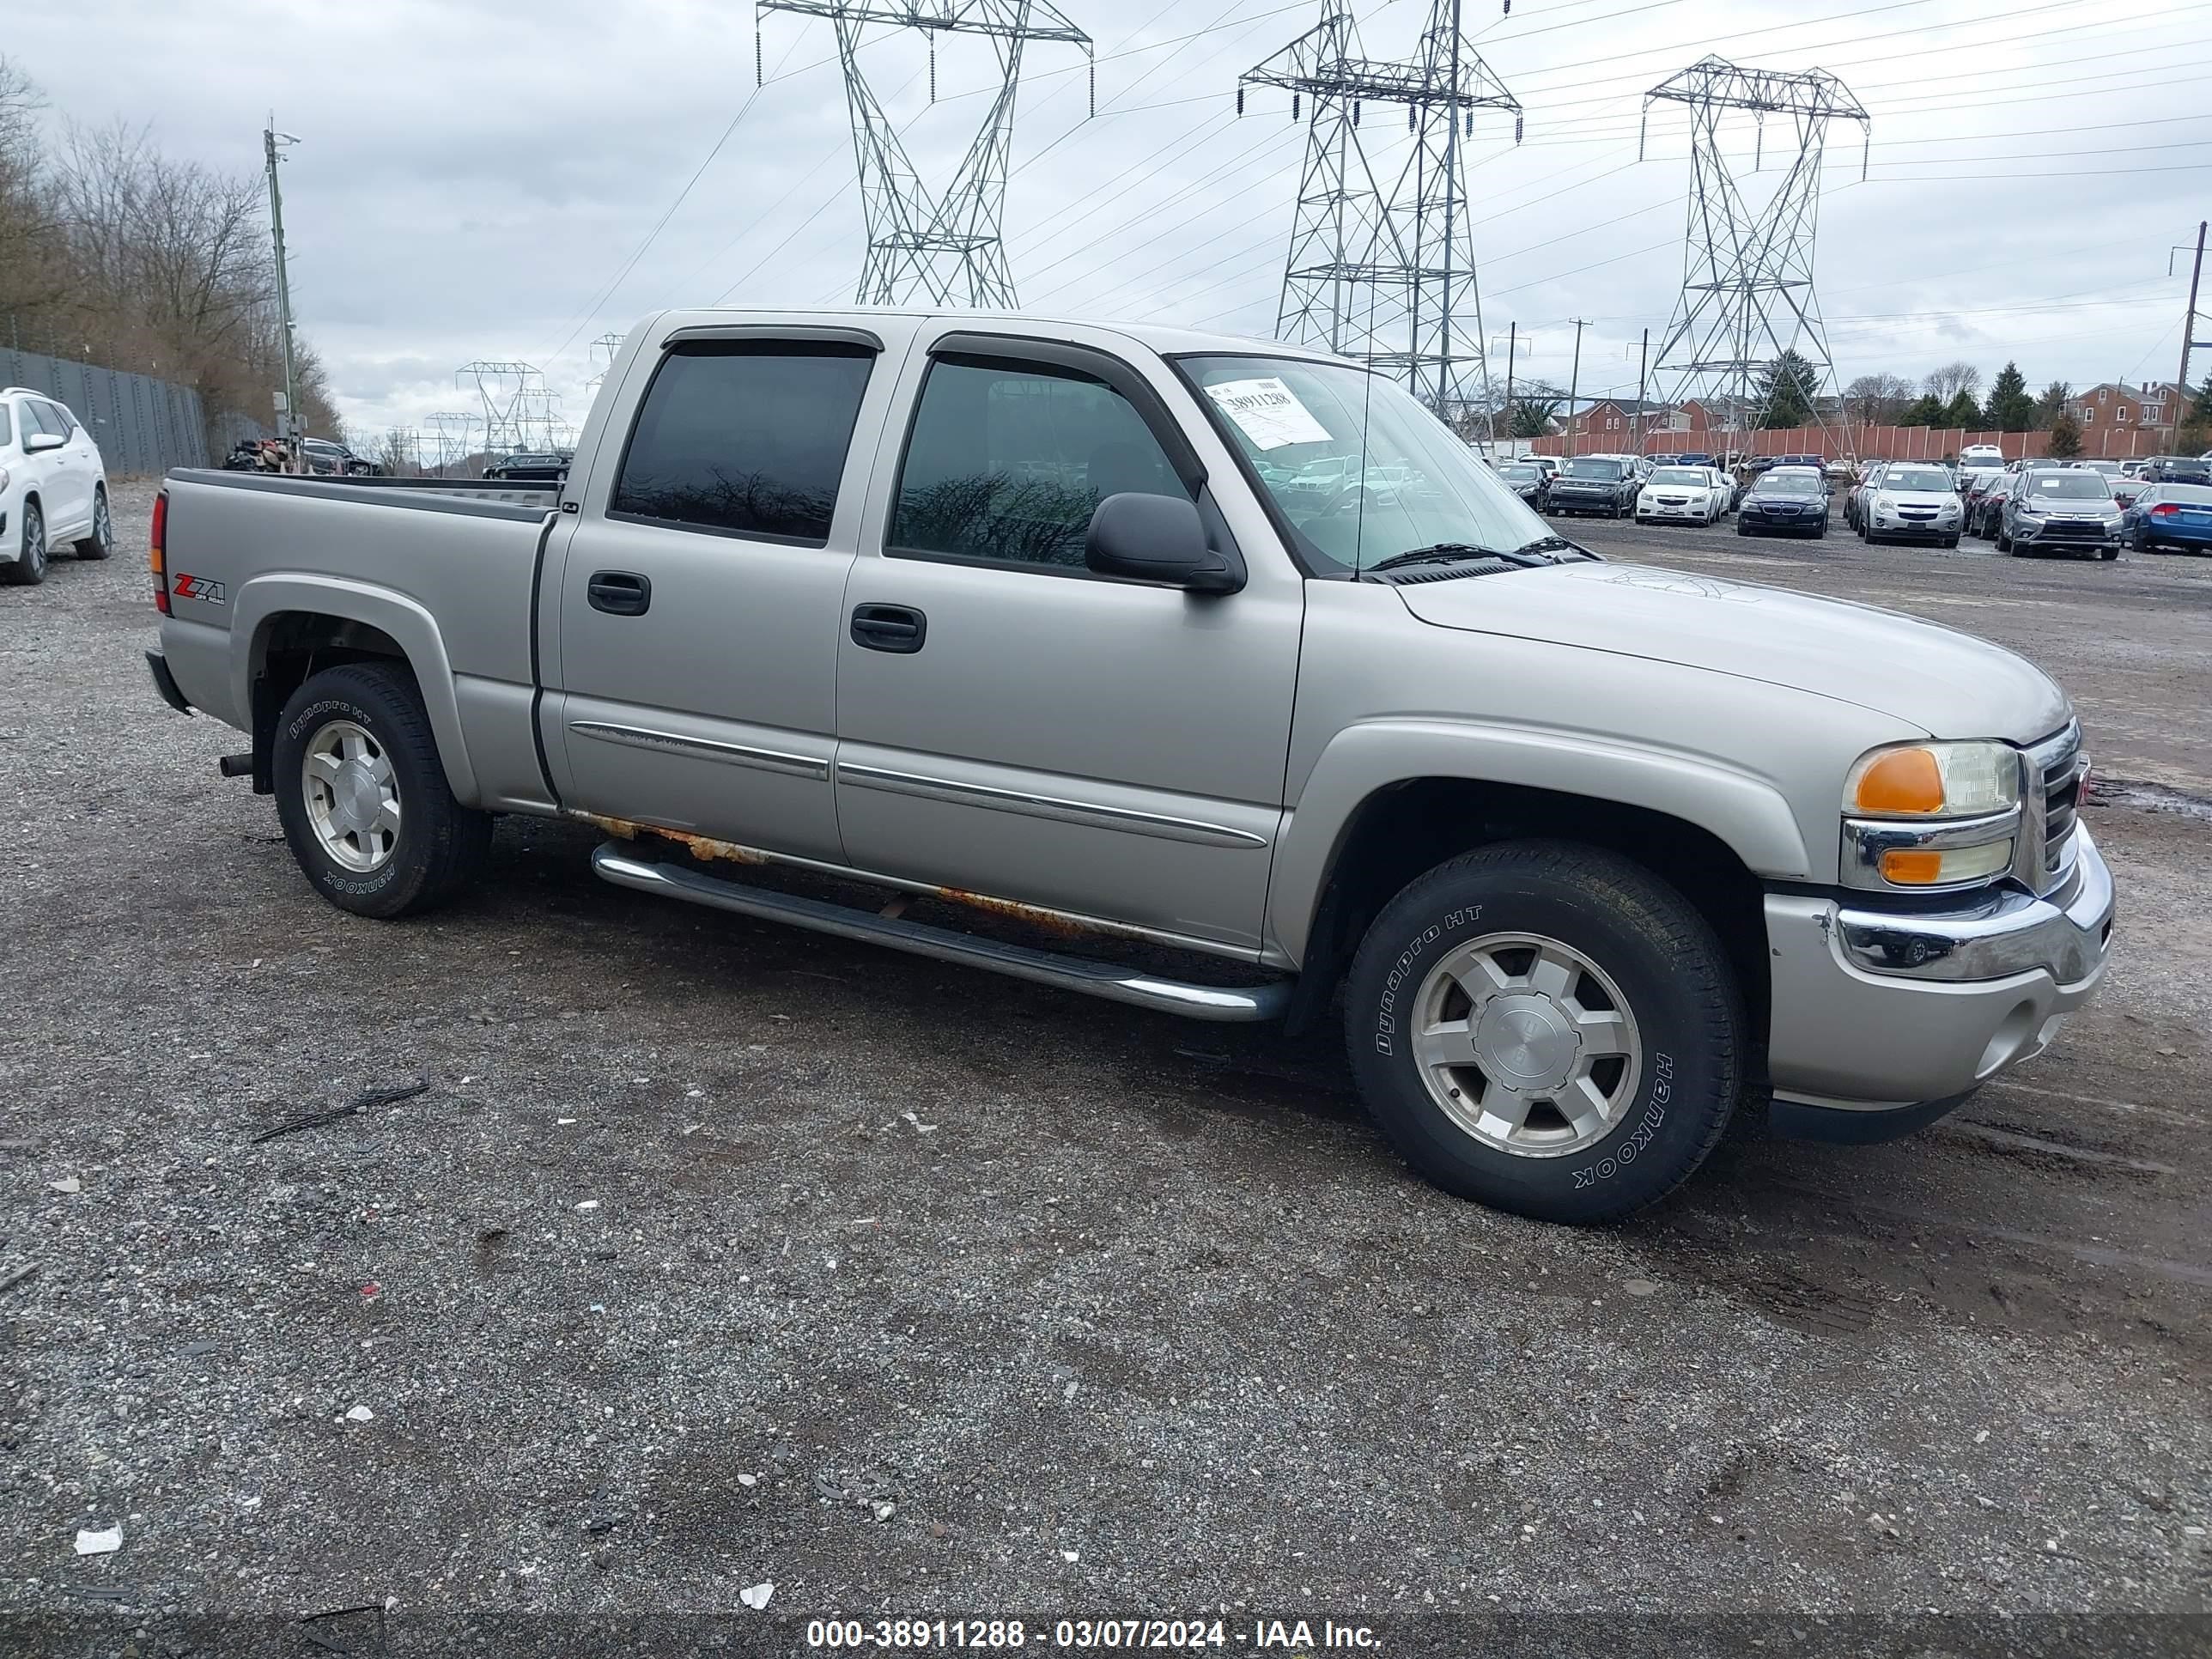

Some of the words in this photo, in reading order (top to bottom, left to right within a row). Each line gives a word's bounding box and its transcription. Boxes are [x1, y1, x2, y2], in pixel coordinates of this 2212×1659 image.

[173, 573, 225, 599] Z71
[289, 701, 349, 739] Dynapro
[351, 706, 372, 725] HT
[1375, 925, 1442, 1056] Dynapro
[1445, 904, 1484, 930] HT
